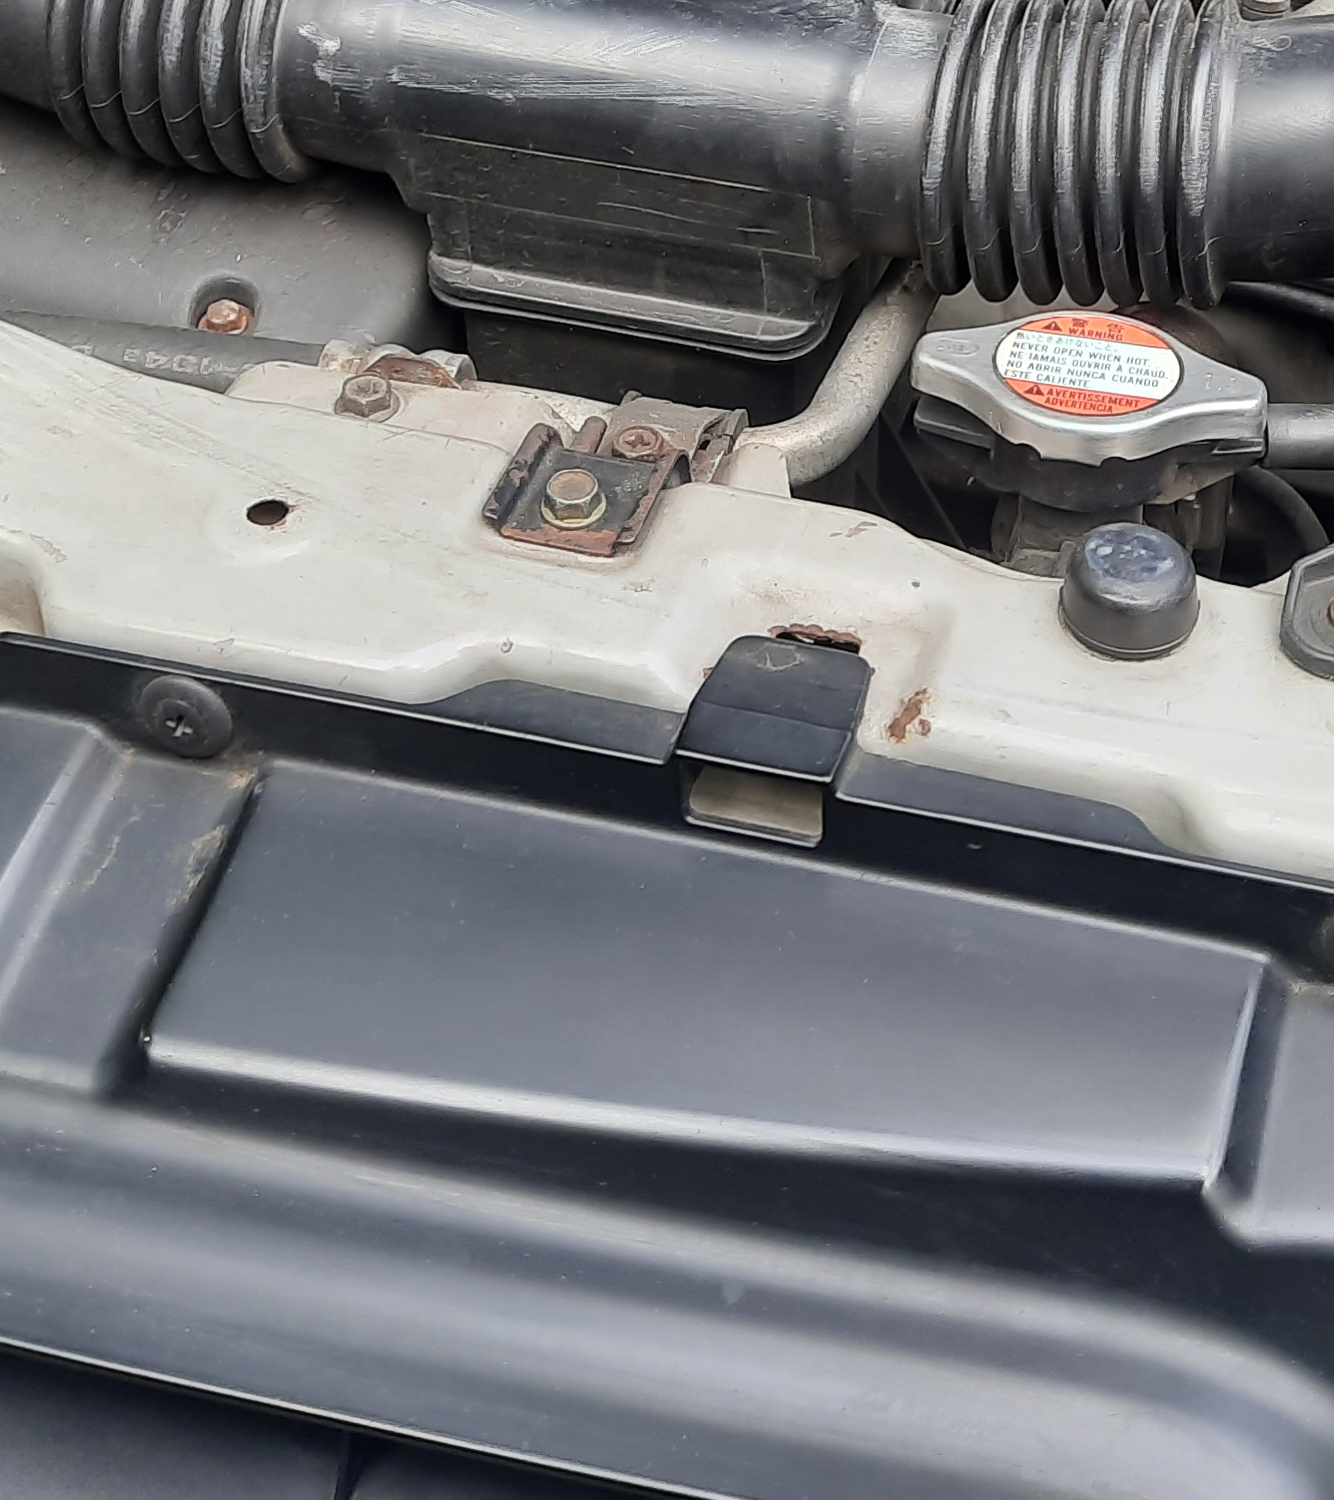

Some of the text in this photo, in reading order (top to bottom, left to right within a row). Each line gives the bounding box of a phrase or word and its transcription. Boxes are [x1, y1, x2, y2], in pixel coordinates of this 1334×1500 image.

[1068, 327, 1124, 342] WARNING
[1009, 350, 1025, 360] NE
[1071, 359, 1112, 372] OUVRIR
[1012, 341, 1049, 353] NEVER
[1053, 346, 1084, 358] OPEN
[1089, 351, 1122, 363] WHEN
[1004, 368, 1032, 380] ESTE
[1007, 359, 1160, 388] NO ABRIR NUNCA CUANDO
[1044, 396, 1114, 414] ADVERTENCIA
[1046, 388, 1142, 408] AVERTISSEMENT
